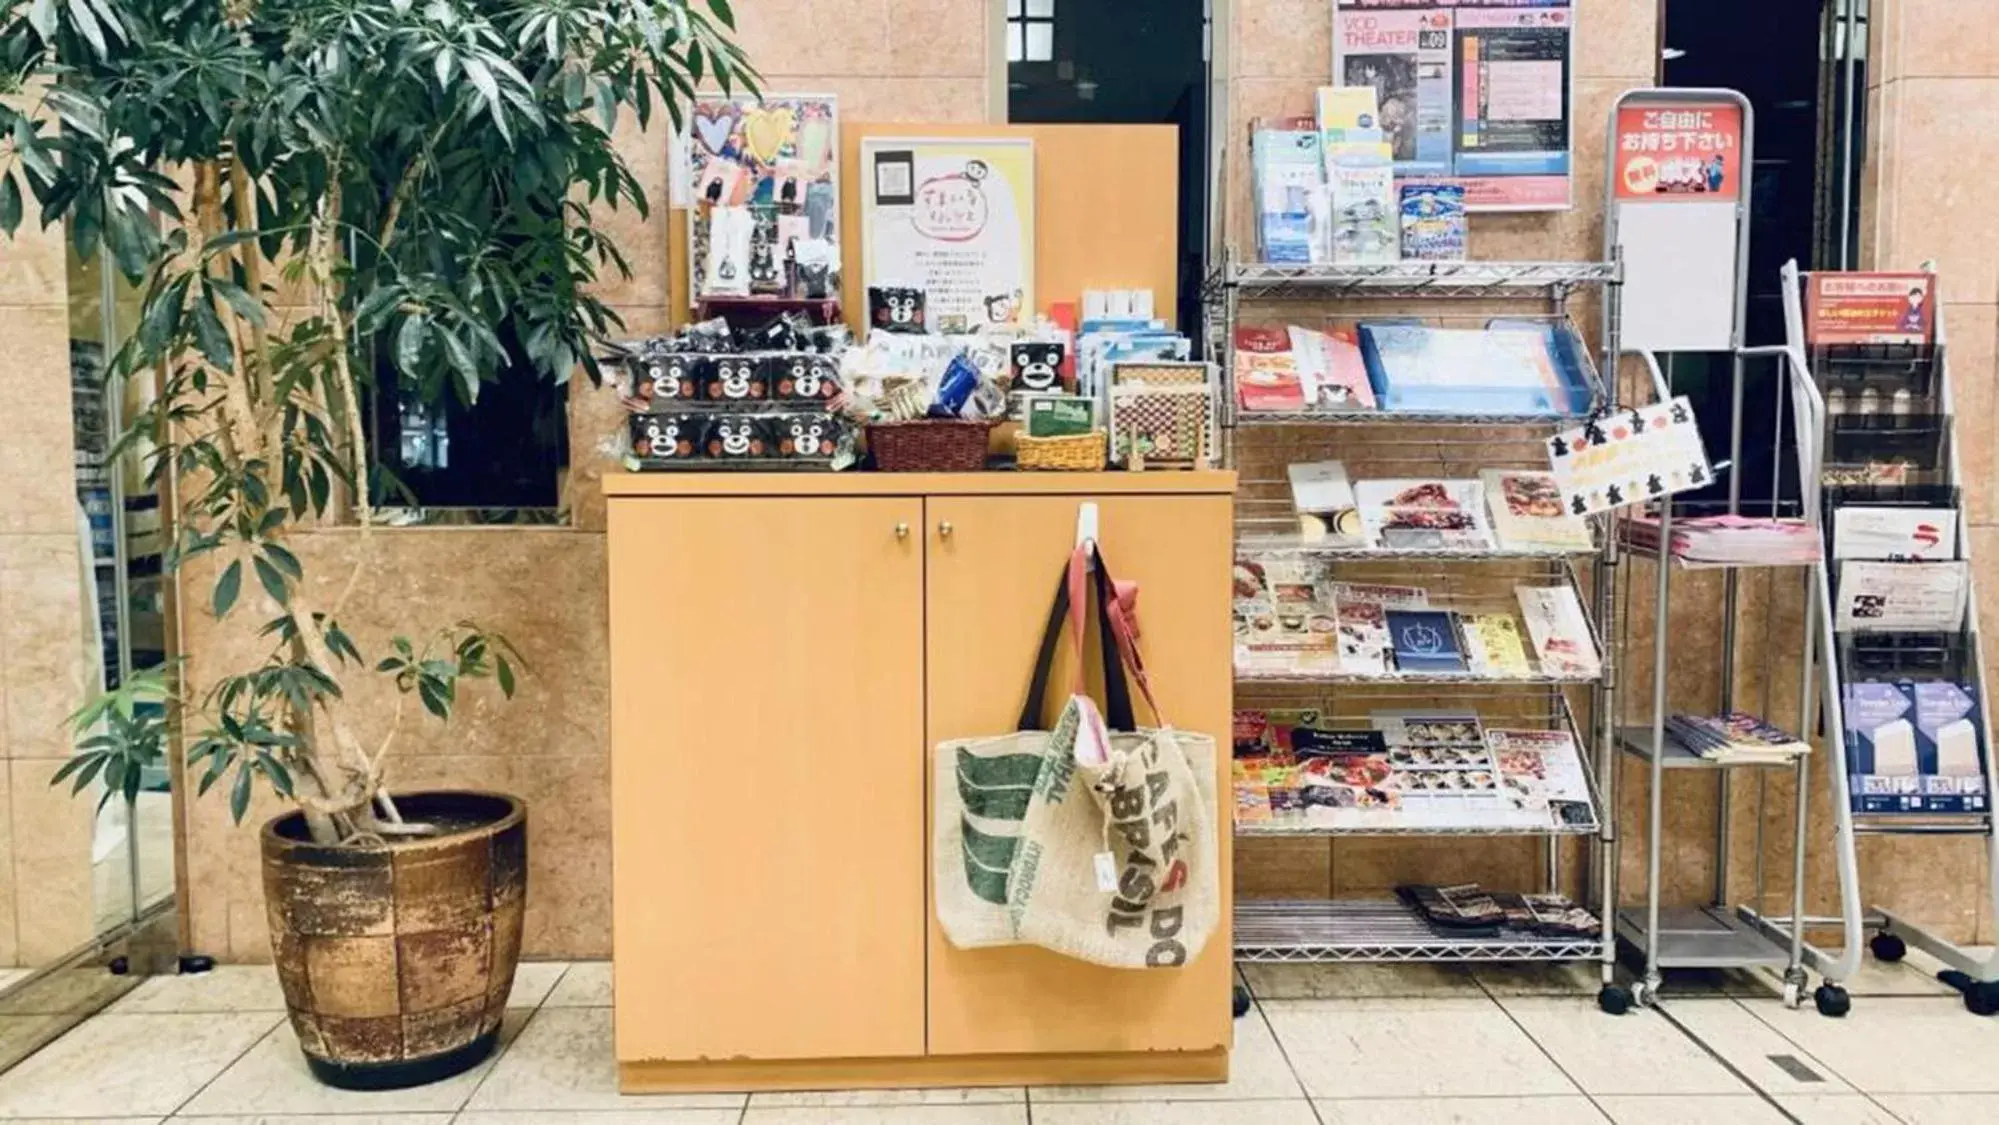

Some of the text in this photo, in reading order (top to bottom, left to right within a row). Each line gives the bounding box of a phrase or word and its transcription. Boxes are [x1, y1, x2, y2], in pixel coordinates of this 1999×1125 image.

[1343, 30, 1417, 46] THEATER
[1643, 111, 1713, 129] ご自由に
[1621, 132, 1733, 151] お持ち下さい
[1145, 904, 1187, 968] DO
